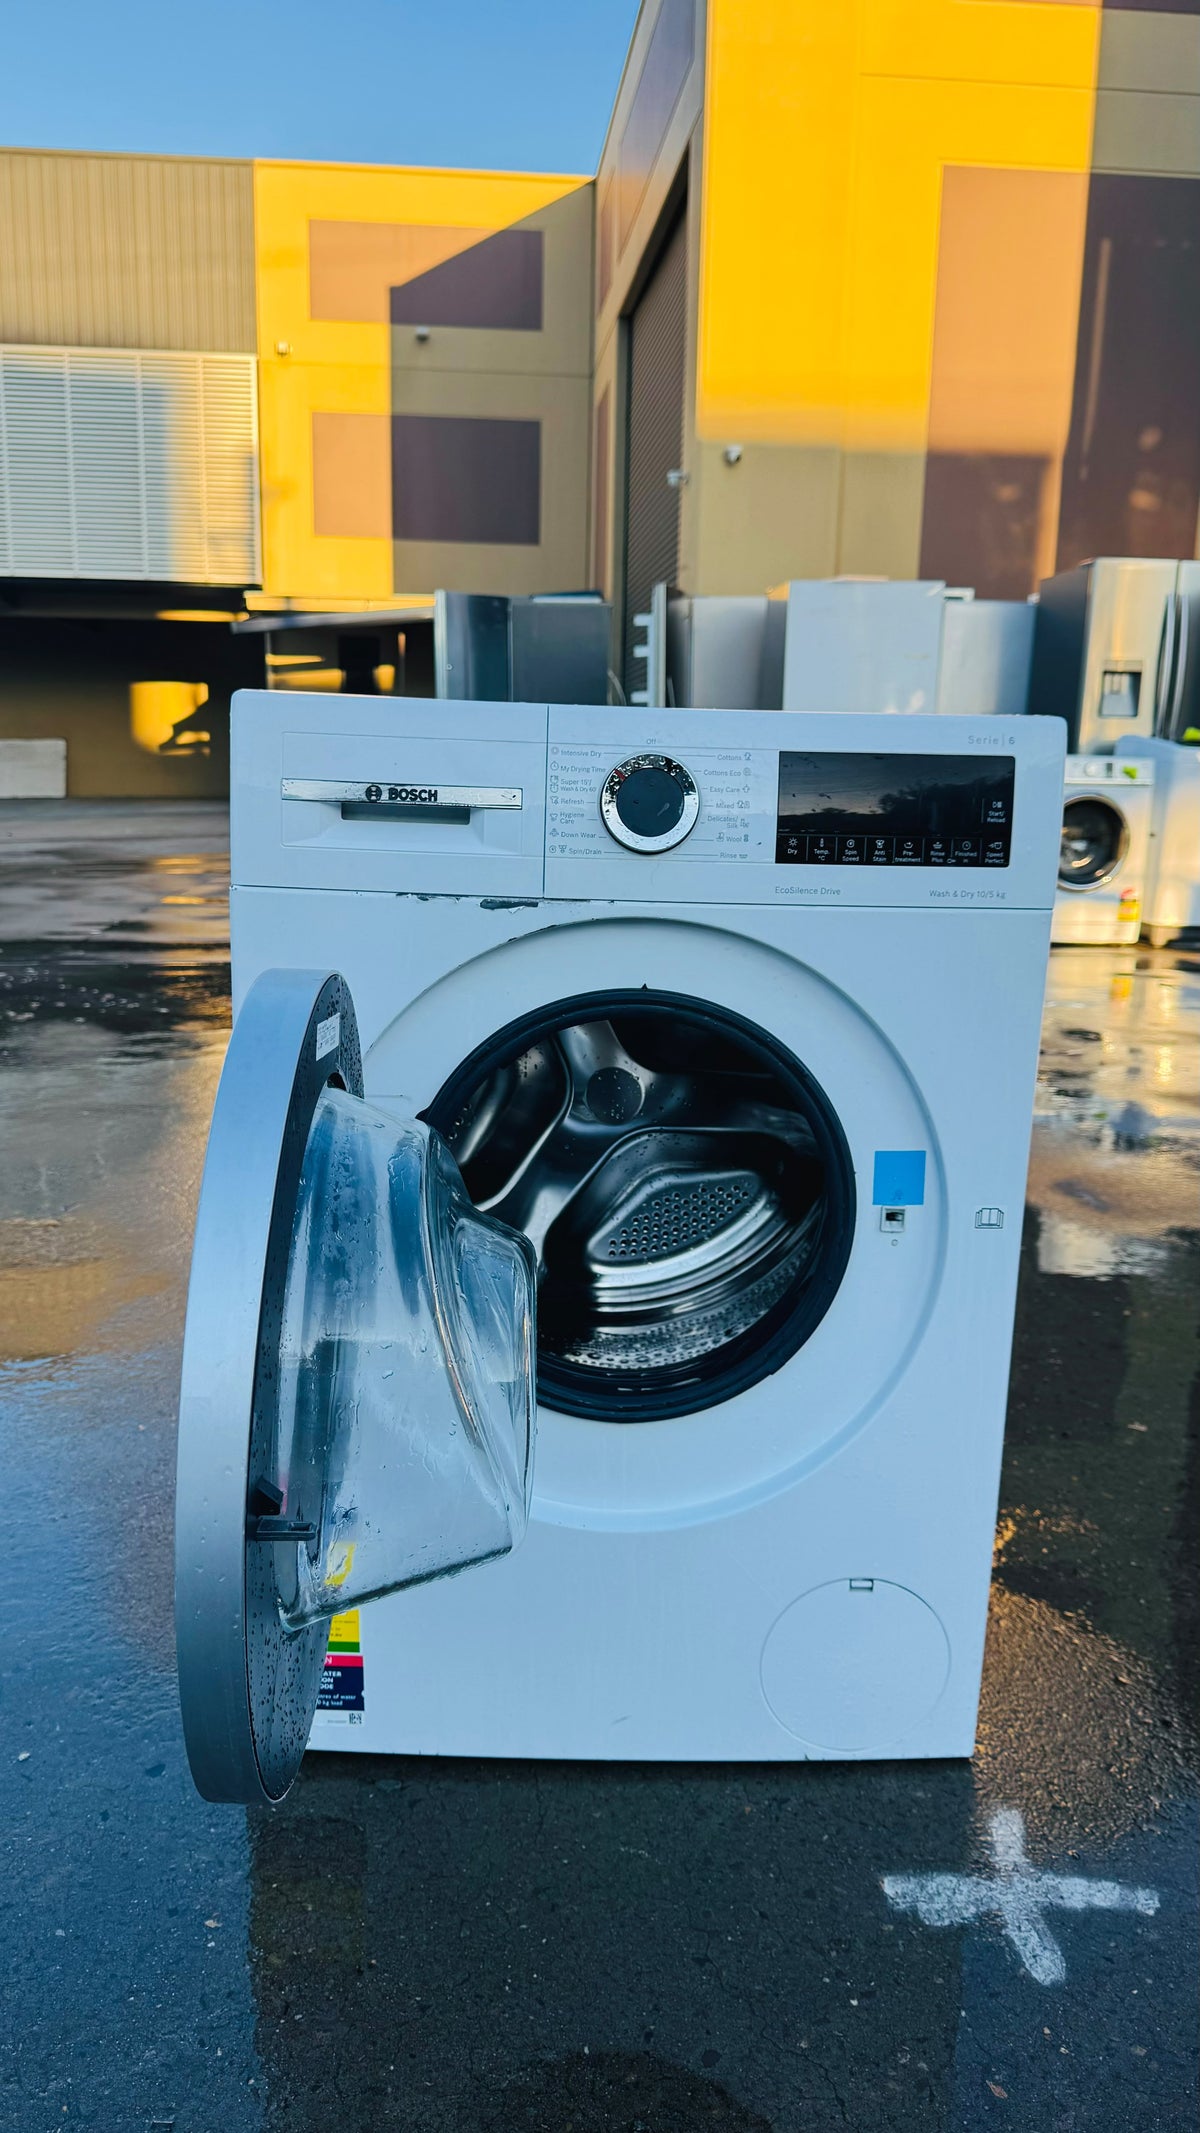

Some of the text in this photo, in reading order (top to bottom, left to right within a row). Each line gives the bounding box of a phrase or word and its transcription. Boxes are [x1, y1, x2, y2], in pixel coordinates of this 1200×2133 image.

[968, 735, 999, 745] Serie
[1008, 736, 1016, 745] 6
[703, 769, 728, 777] Cottons
[388, 787, 438, 802] BOSCH
[569, 848, 602, 856] Spin/Drain
[788, 848, 798, 856] Dry
[775, 886, 841, 896] EcoSilence Drive
[929, 889, 1007, 899] Wash & Dry 10/5 kg
